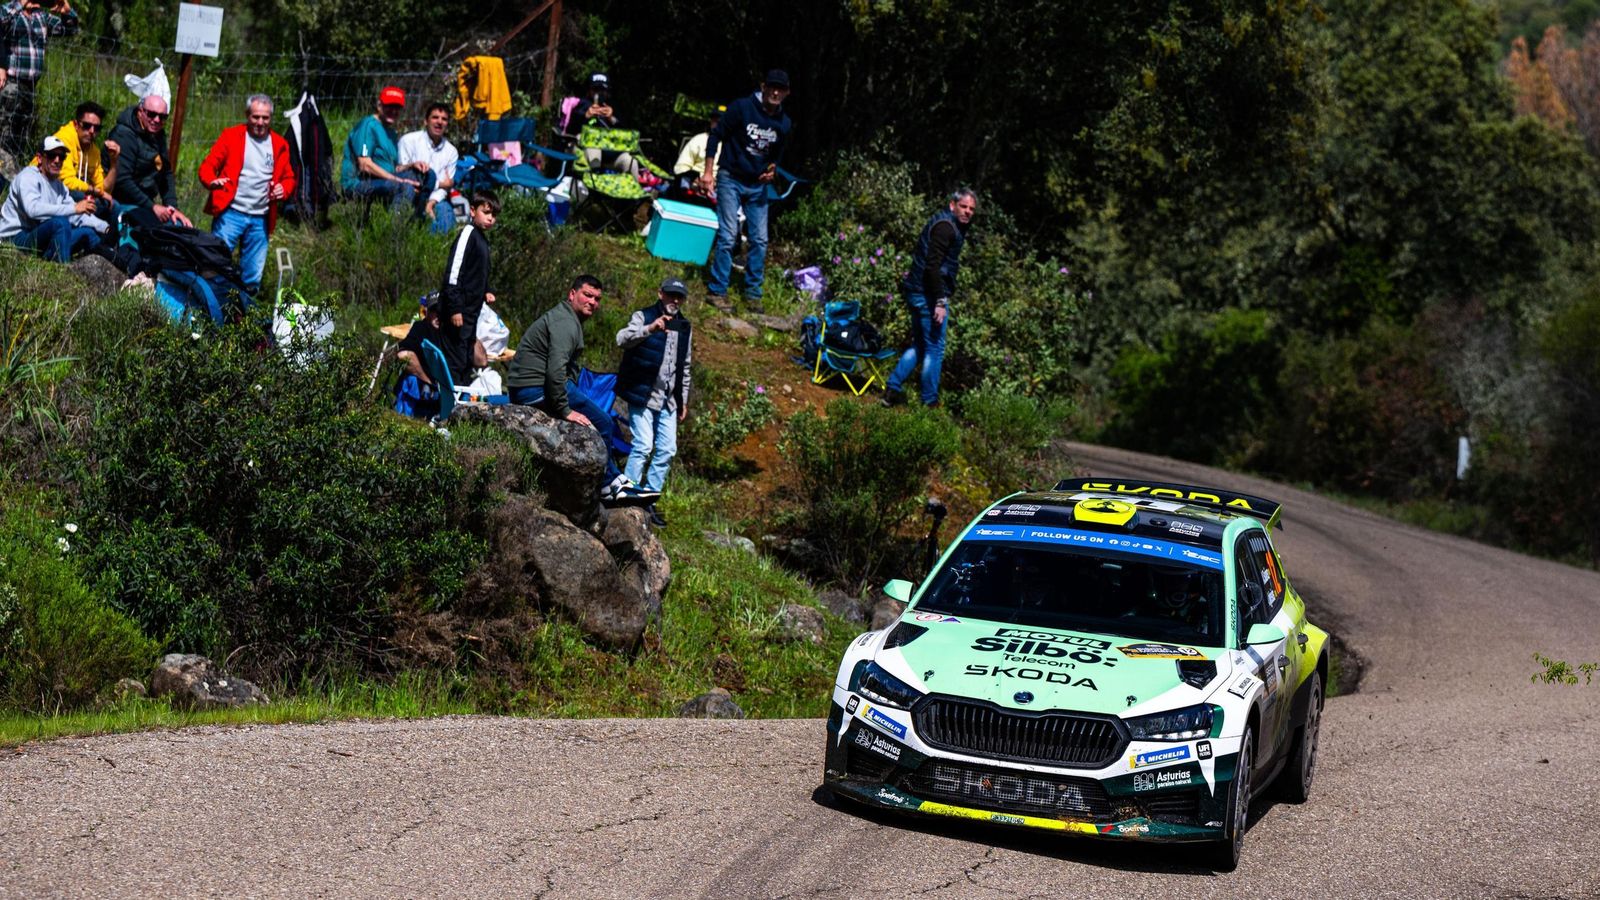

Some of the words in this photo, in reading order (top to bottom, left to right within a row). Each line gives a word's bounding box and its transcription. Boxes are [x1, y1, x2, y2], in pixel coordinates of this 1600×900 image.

[1031, 531, 1071, 540] FOLLOW
[1000, 629, 1106, 650] MOTUL
[1003, 653, 1076, 670] Telecom
[873, 715, 903, 734] MICHELIN
[873, 735, 902, 755] Asturias
[1147, 750, 1186, 762] MICHELIN
[1156, 770, 1191, 782] Asturias
